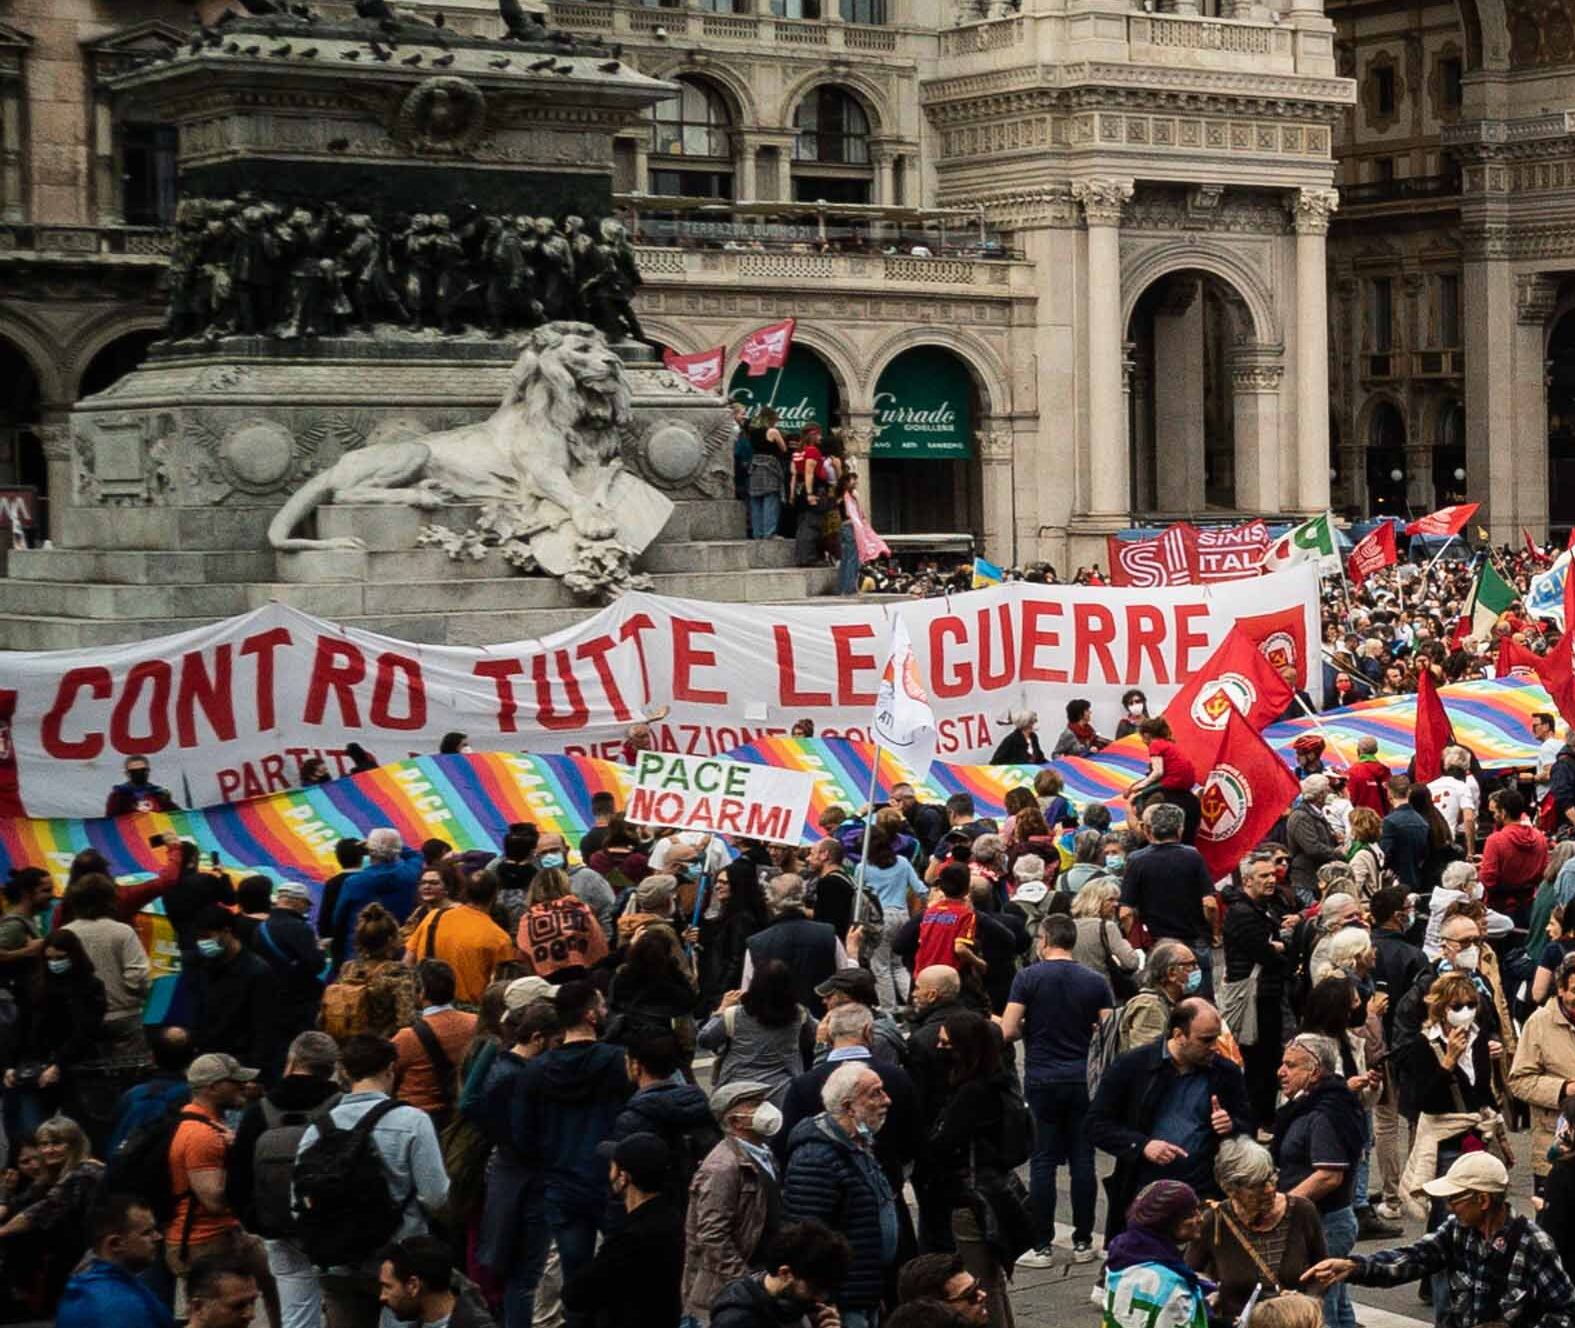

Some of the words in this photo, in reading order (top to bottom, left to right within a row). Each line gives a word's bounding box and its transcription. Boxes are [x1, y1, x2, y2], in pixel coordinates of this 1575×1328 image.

[729, 388, 816, 420] urado
[1198, 524, 1264, 546] SINIS
[1200, 554, 1252, 572] ITAL
[41, 627, 428, 760] CONTRO
[473, 613, 728, 732] TUTTE
[773, 624, 878, 707] LE
[929, 600, 1210, 698] GUERRE
[217, 748, 378, 803] PARTT
[395, 768, 452, 824] PACE
[504, 757, 564, 819] PACE
[639, 753, 751, 797] PACE
